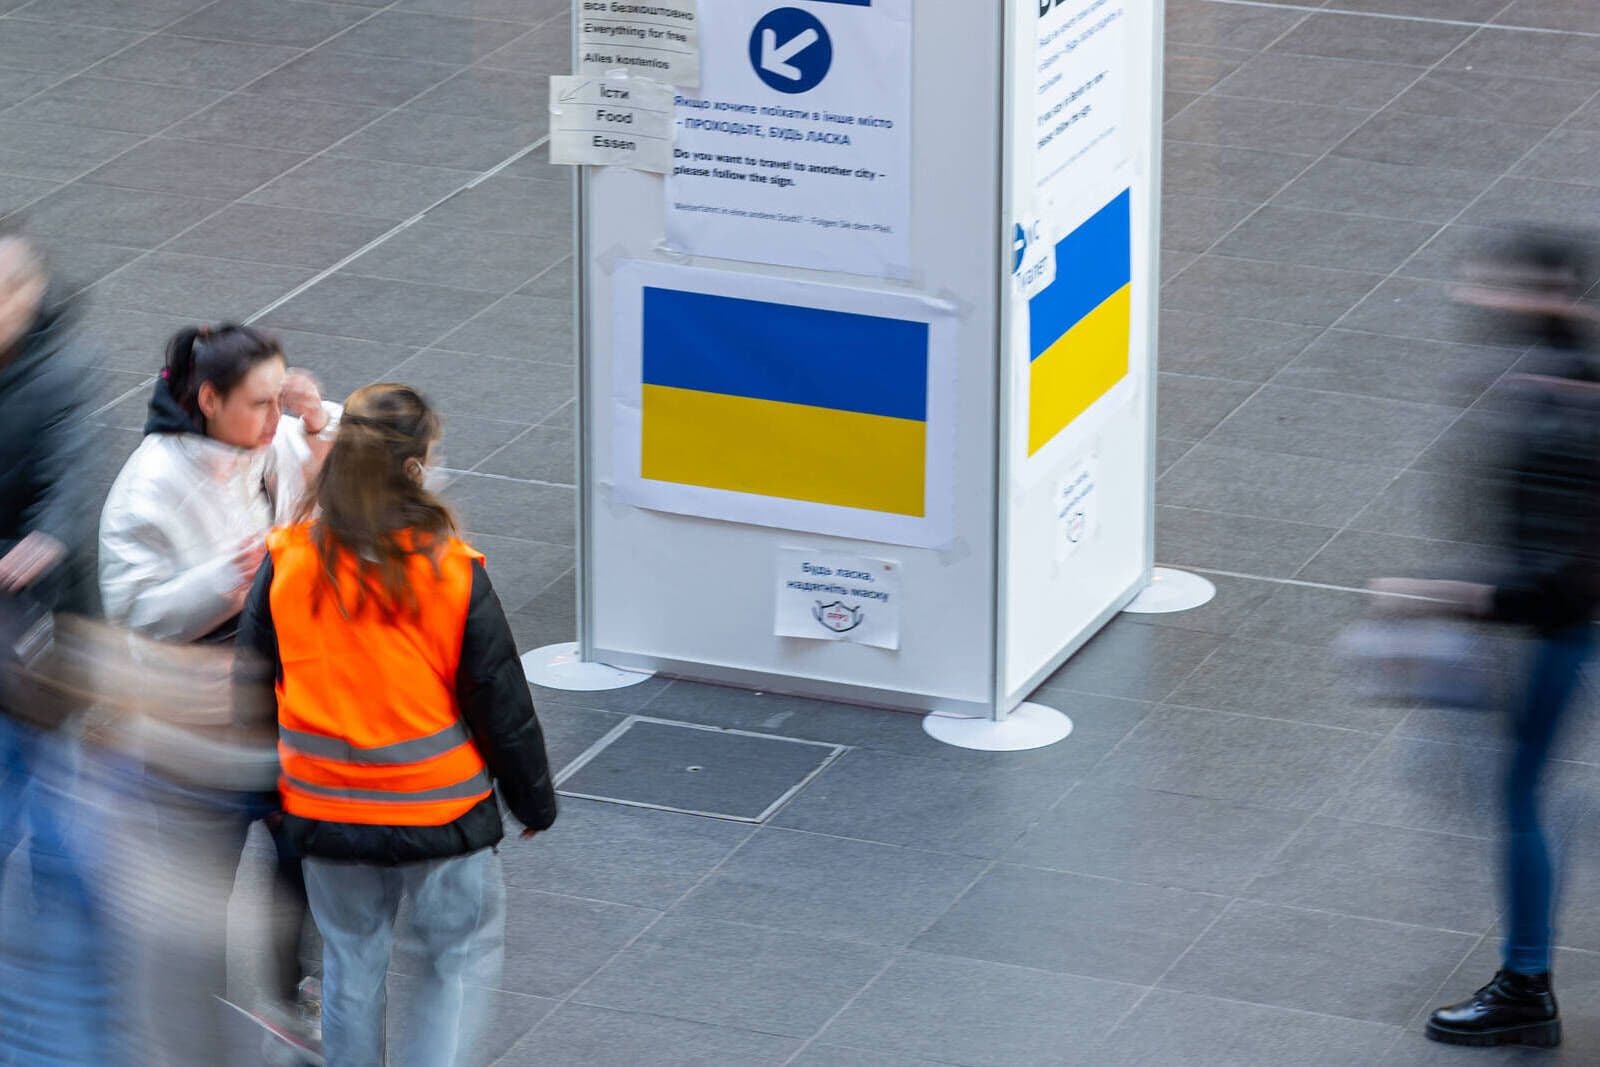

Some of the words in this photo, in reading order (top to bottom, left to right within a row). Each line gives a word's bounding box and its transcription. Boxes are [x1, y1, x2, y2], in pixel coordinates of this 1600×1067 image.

[584, 23, 646, 39] Everything
[648, 28, 664, 38] for
[666, 30, 687, 42] free
[584, 53, 613, 63] Alles
[616, 54, 671, 70] kostenlos
[673, 95, 711, 110] Якщо
[596, 110, 633, 124] Food
[592, 136, 636, 150] Essen
[769, 126, 803, 142] БУДЬ
[806, 131, 851, 146] ЛАСКА
[673, 148, 689, 160] Do
[693, 152, 713, 164] you
[716, 155, 743, 166] want
[745, 156, 757, 167] to
[759, 156, 791, 171] travel
[794, 160, 806, 171] to
[808, 163, 852, 178] another
[855, 166, 876, 181] city
[673, 166, 710, 179] please
[713, 168, 746, 181] follow
[749, 171, 767, 184] the
[770, 173, 796, 188] sign.
